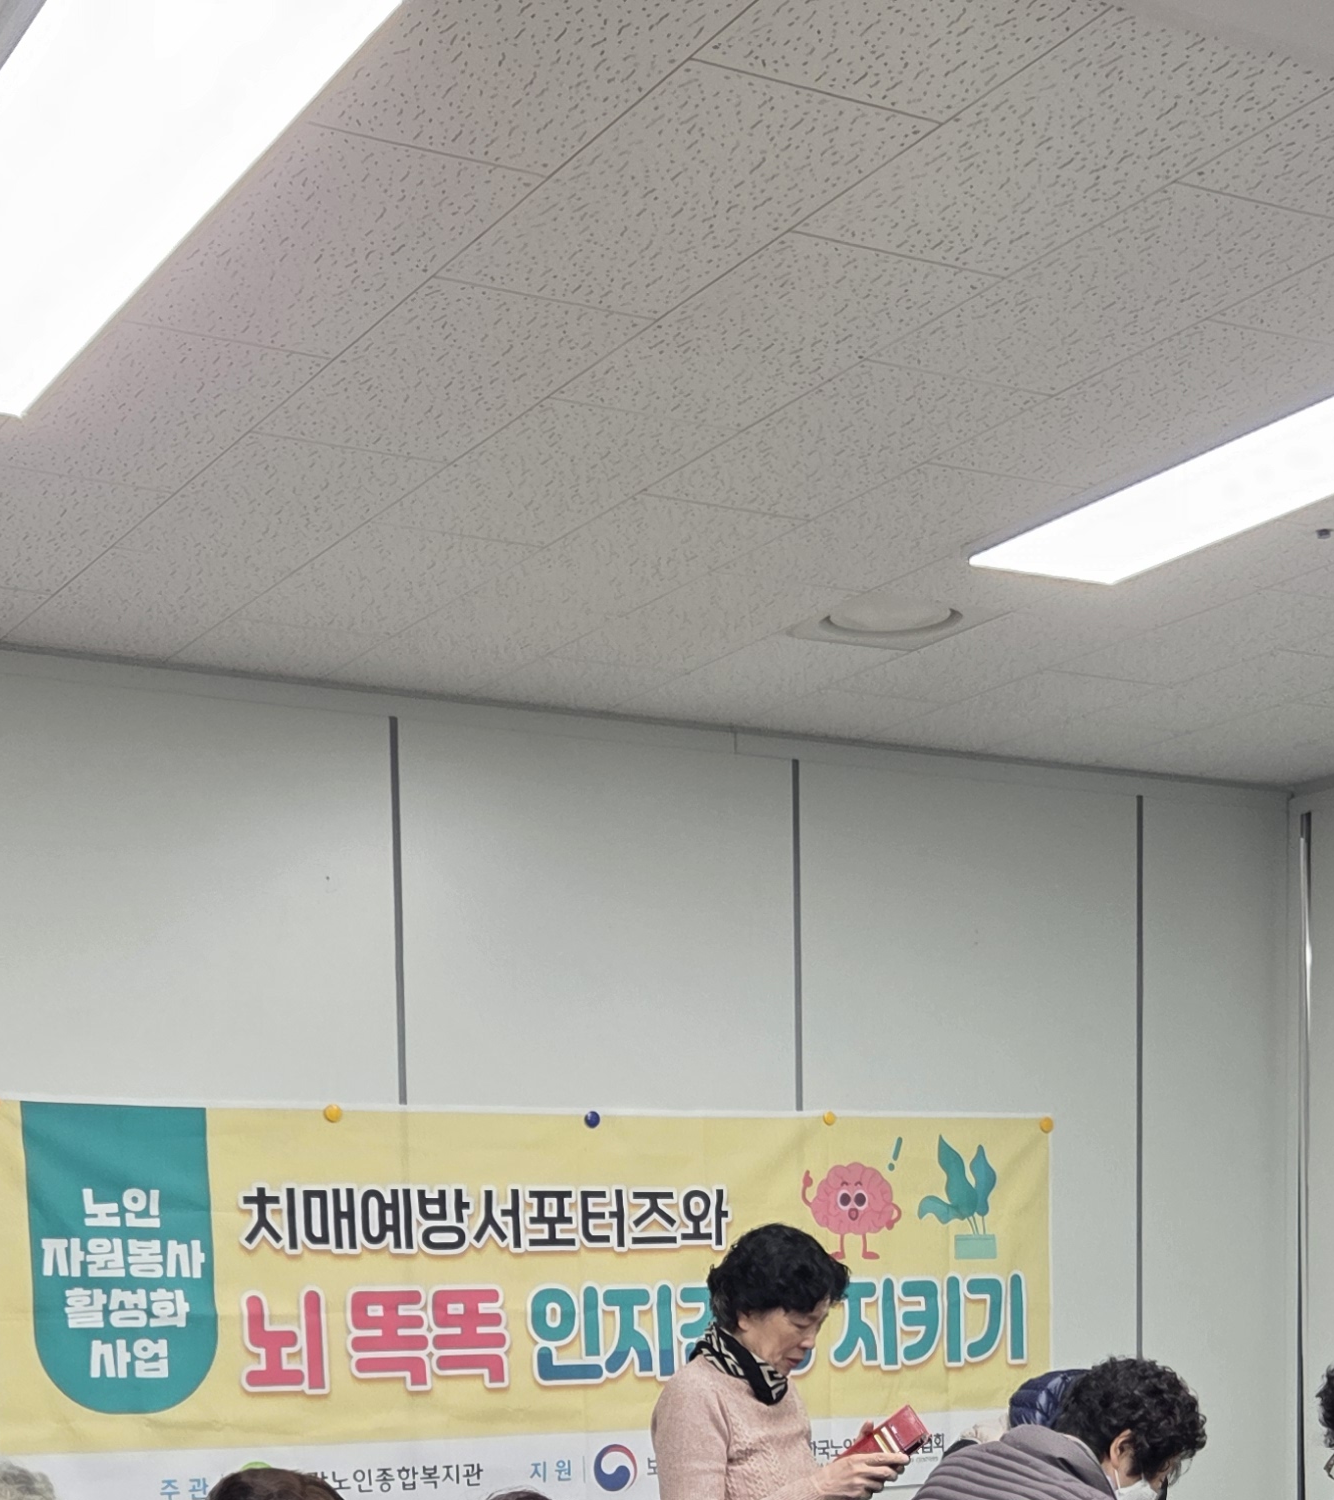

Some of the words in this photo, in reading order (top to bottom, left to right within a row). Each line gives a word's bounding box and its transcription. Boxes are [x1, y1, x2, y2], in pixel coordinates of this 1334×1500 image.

[82, 1188, 161, 1228] 노인
[243, 1187, 728, 1250] 치매예방서포터즈와
[41, 1237, 205, 1279] 자원봉사
[64, 1287, 190, 1329] 활성화
[246, 1289, 326, 1391] 뇌
[350, 1288, 508, 1389] 똑똑
[832, 1273, 1025, 1367] 지키기
[90, 1338, 169, 1379] 사업
[530, 1460, 573, 1482] 지원
